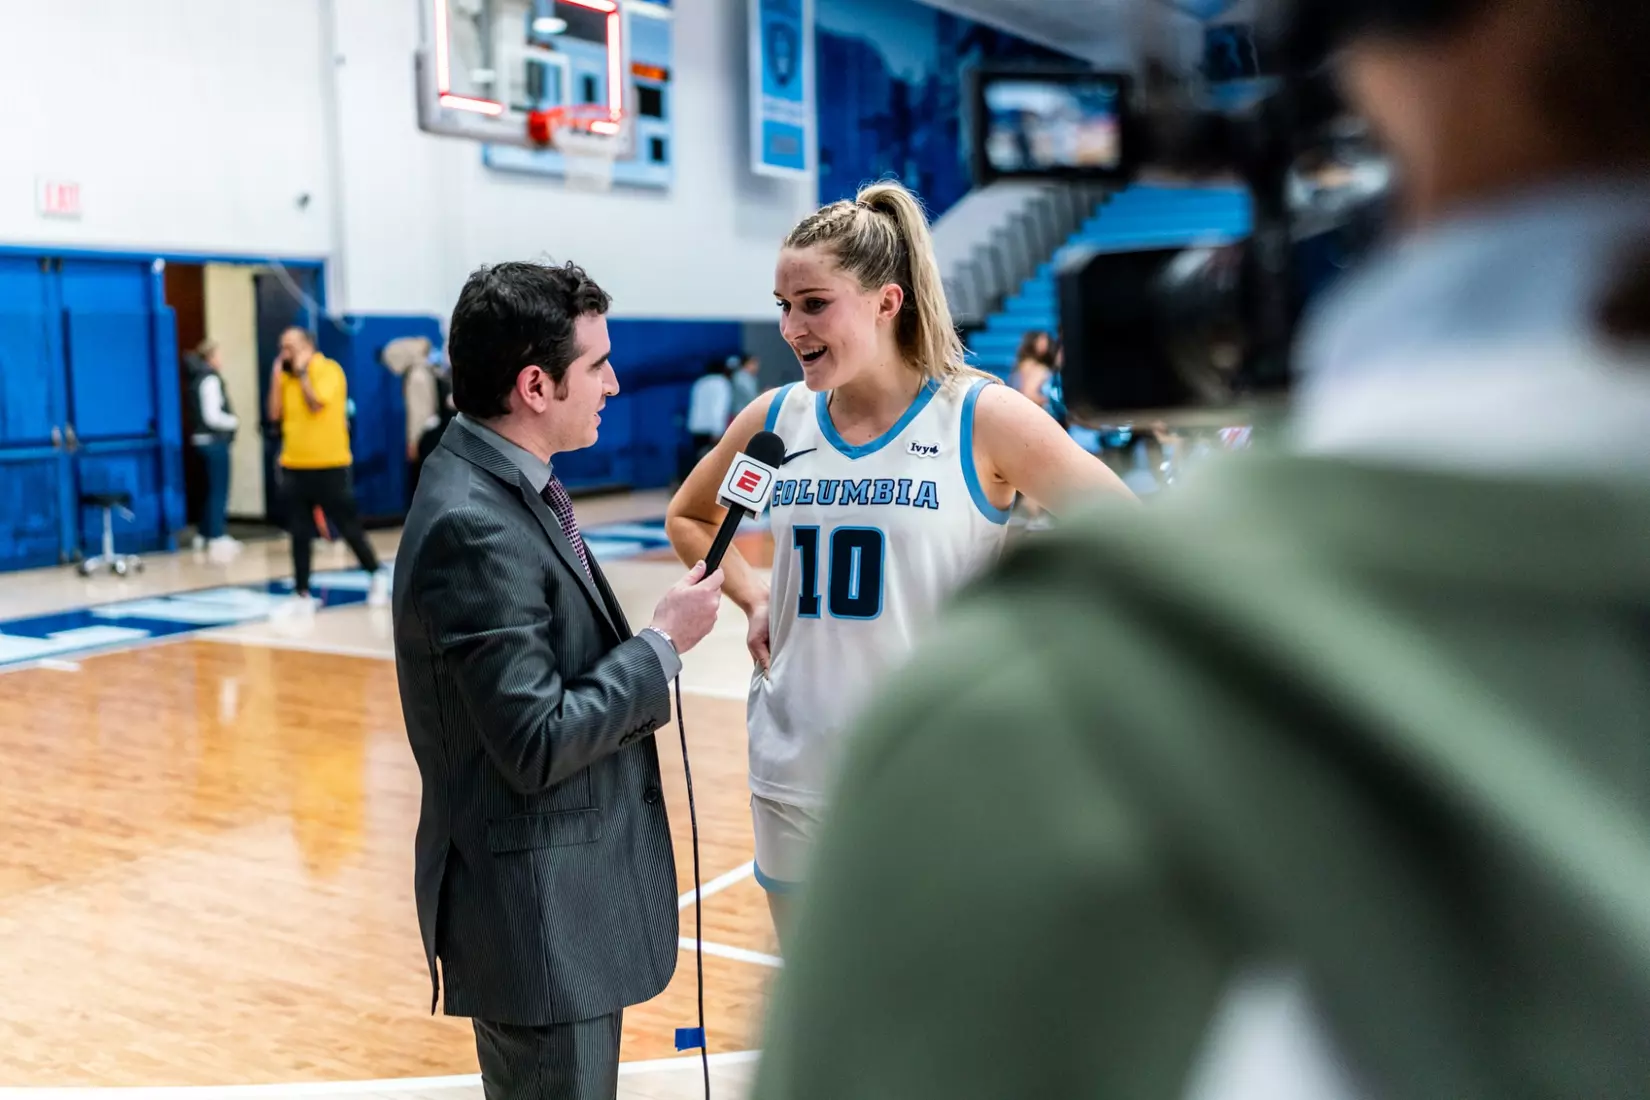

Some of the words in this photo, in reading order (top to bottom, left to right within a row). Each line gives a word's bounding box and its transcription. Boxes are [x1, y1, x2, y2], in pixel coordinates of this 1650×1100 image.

[910, 442, 930, 455] Ivy
[772, 479, 939, 509] COLUMBIA
[793, 525, 885, 620] 10
